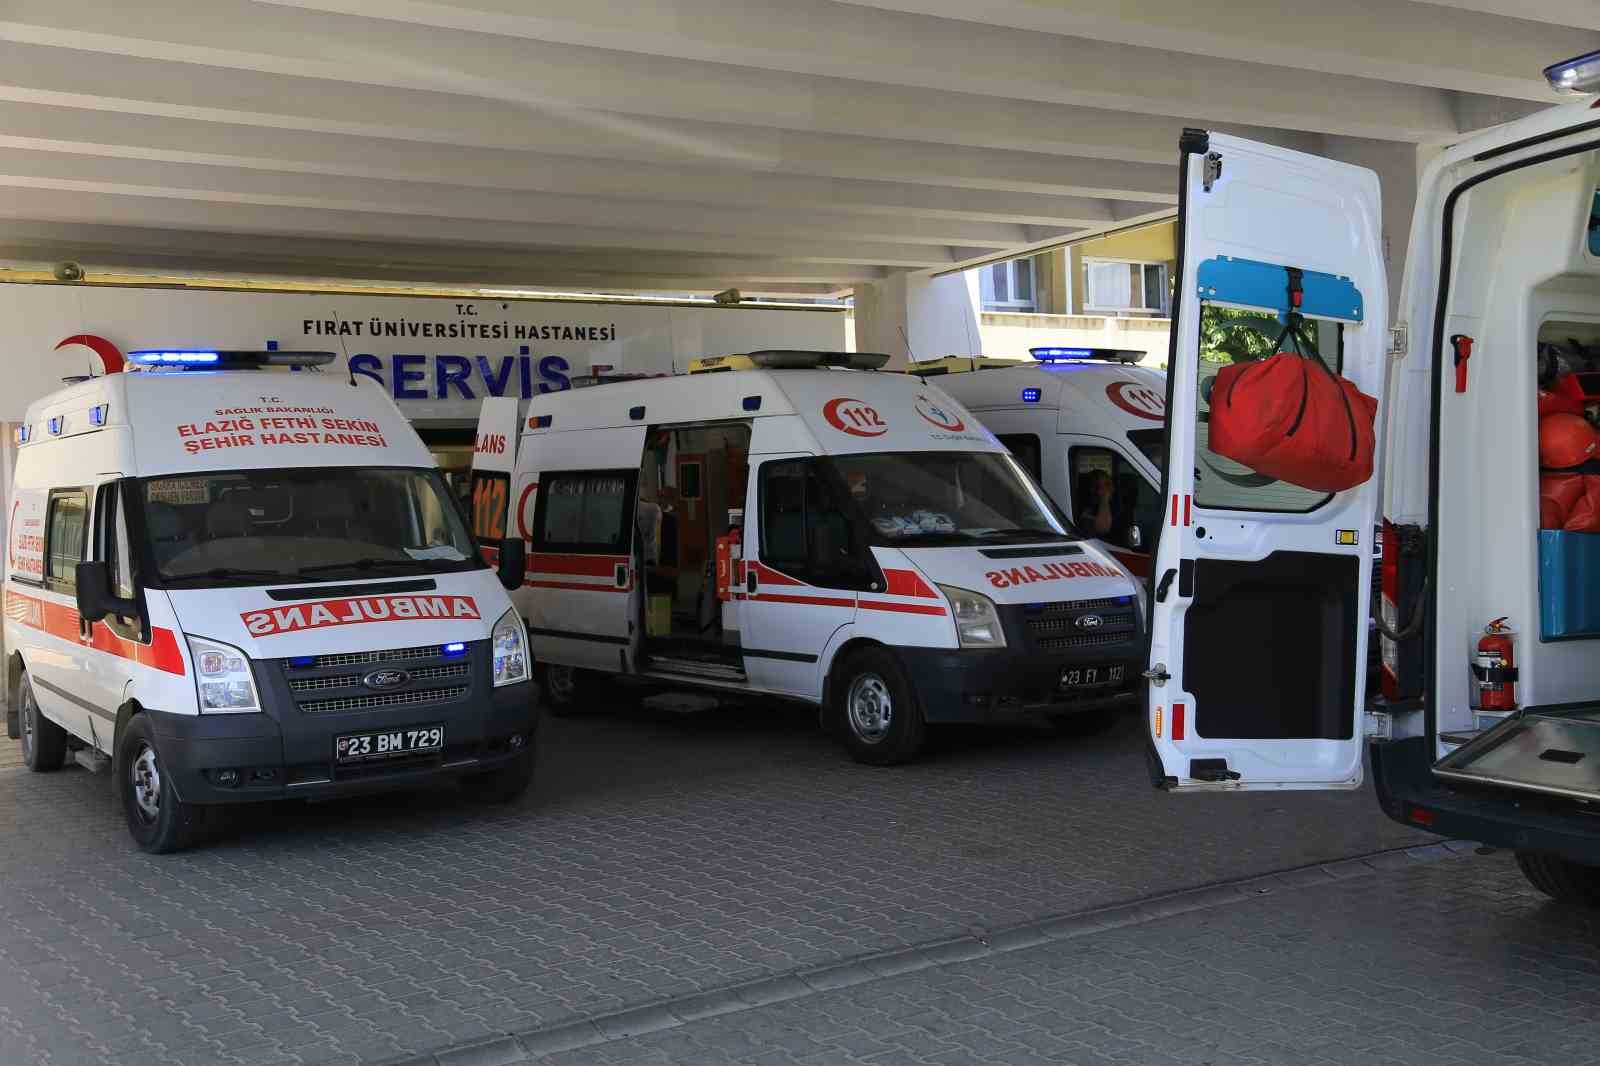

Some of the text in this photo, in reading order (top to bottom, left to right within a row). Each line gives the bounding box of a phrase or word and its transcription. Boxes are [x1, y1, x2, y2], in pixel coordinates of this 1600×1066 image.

[455, 303, 478, 316] T.C.
[302, 317, 616, 341] FIRAT ÜNİVERSİTESİ HASTANESİ
[348, 345, 572, 400] SERVİS
[176, 414, 381, 437] ELAZIĞ FETHİ SEKİN
[843, 407, 887, 427] 112
[183, 432, 389, 455] ŞEHİR HASTANESİ
[472, 478, 507, 540] 112
[1068, 669, 1080, 684] 23
[1109, 667, 1121, 681] 112
[348, 728, 442, 756] 23 BM 729
